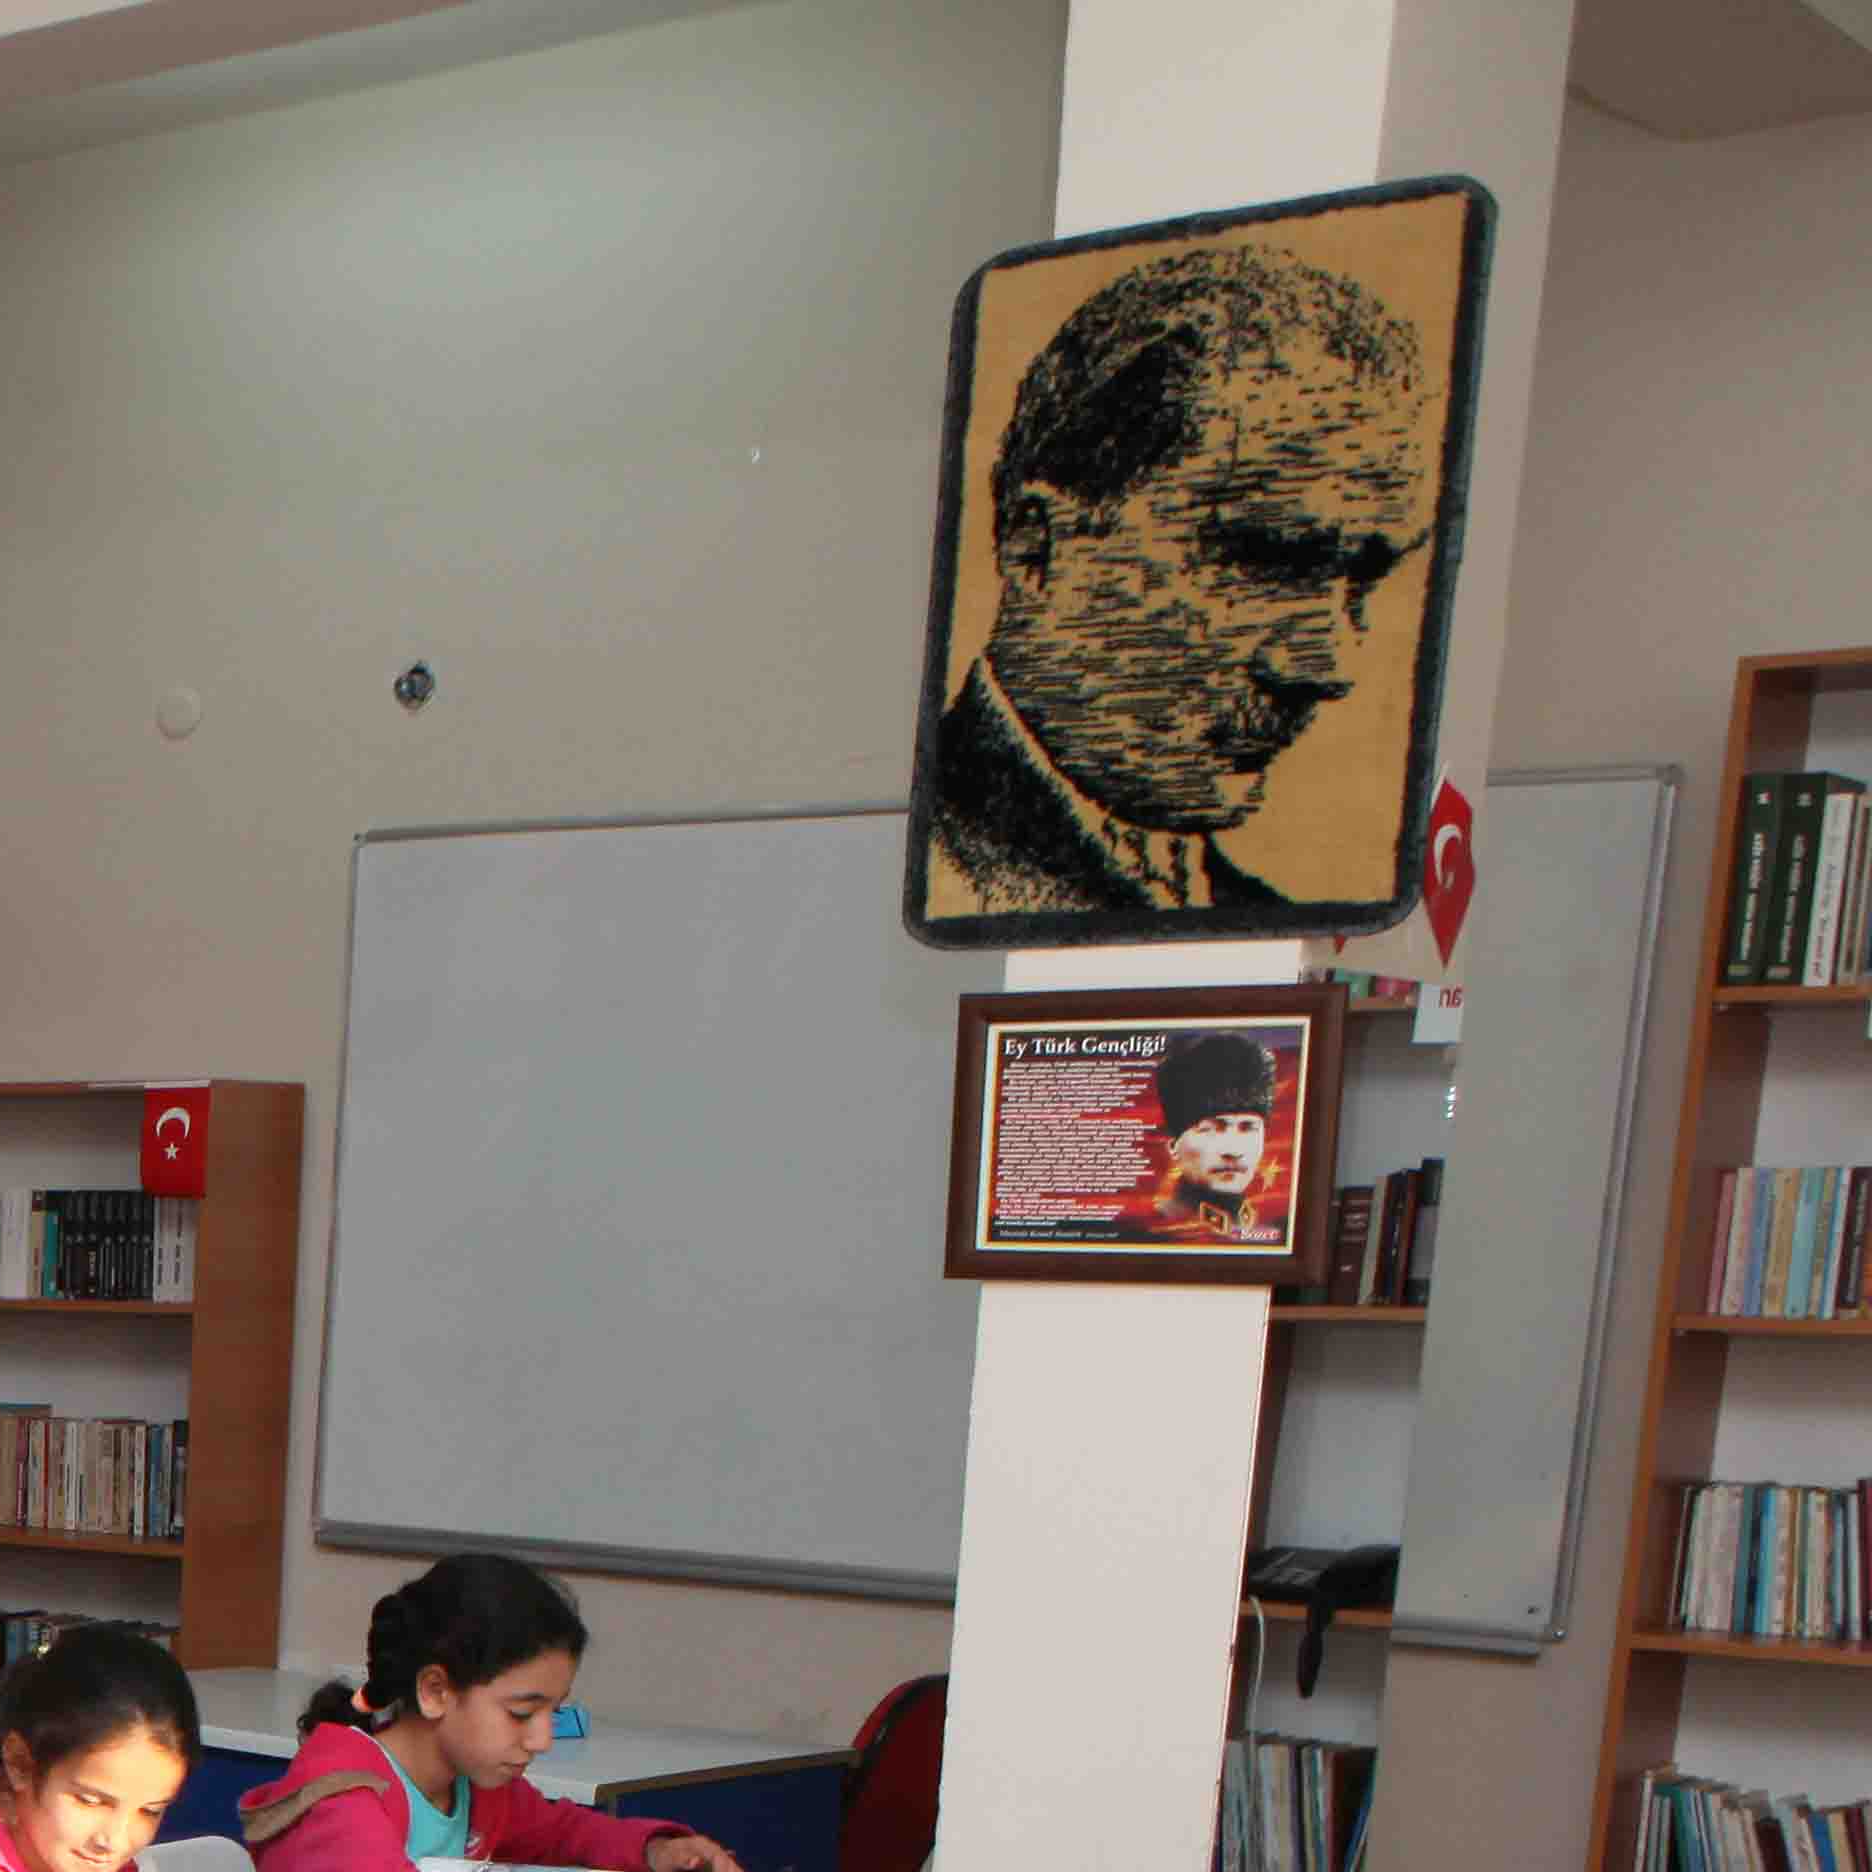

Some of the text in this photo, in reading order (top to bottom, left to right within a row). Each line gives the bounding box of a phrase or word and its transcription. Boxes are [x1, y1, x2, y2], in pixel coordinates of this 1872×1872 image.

[1005, 1033, 1168, 1060] Ey Türk Gençliği!
